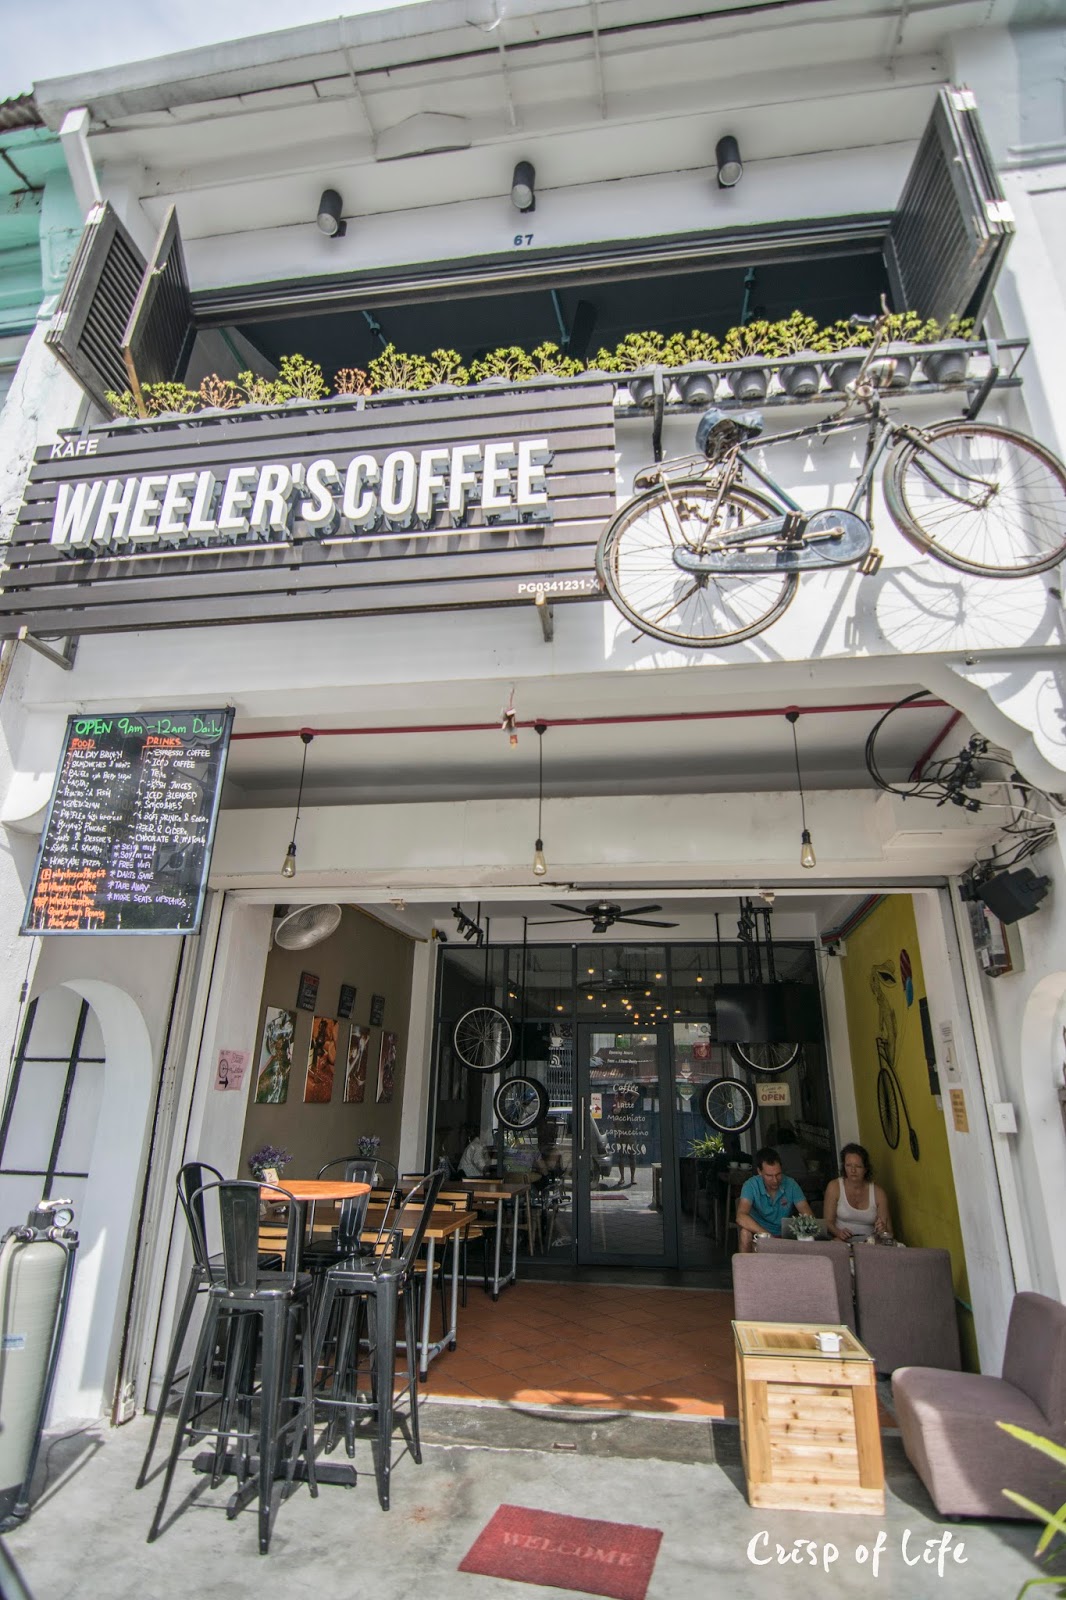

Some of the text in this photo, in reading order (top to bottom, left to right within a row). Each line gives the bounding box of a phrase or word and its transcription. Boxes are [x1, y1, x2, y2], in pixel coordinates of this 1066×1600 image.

[513, 233, 534, 246] 67
[50, 438, 99, 459] KAFE
[50, 438, 551, 550] WHEELER'S COFFEE
[517, 578, 600, 594] PG0341231-X
[75, 718, 113, 735] OPEN
[193, 718, 223, 737] Daily
[71, 738, 96, 749] FOOD
[146, 736, 183, 746] DRINKS
[153, 748, 211, 757] ESPRESSO COFFEE
[173, 760, 196, 769] COFFEE
[170, 780, 193, 790] JUICES
[135, 833, 169, 843] CHOCOLATE
[118, 860, 134, 869] FREE
[116, 870, 136, 879] DARTS
[131, 882, 151, 893] AWAY
[113, 892, 131, 902] MORE
[133, 894, 152, 903] SEATS
[612, 1082, 639, 1094] Coffee
[761, 1093, 786, 1102] OPEN
[502, 1531, 635, 1567] WELCOME
